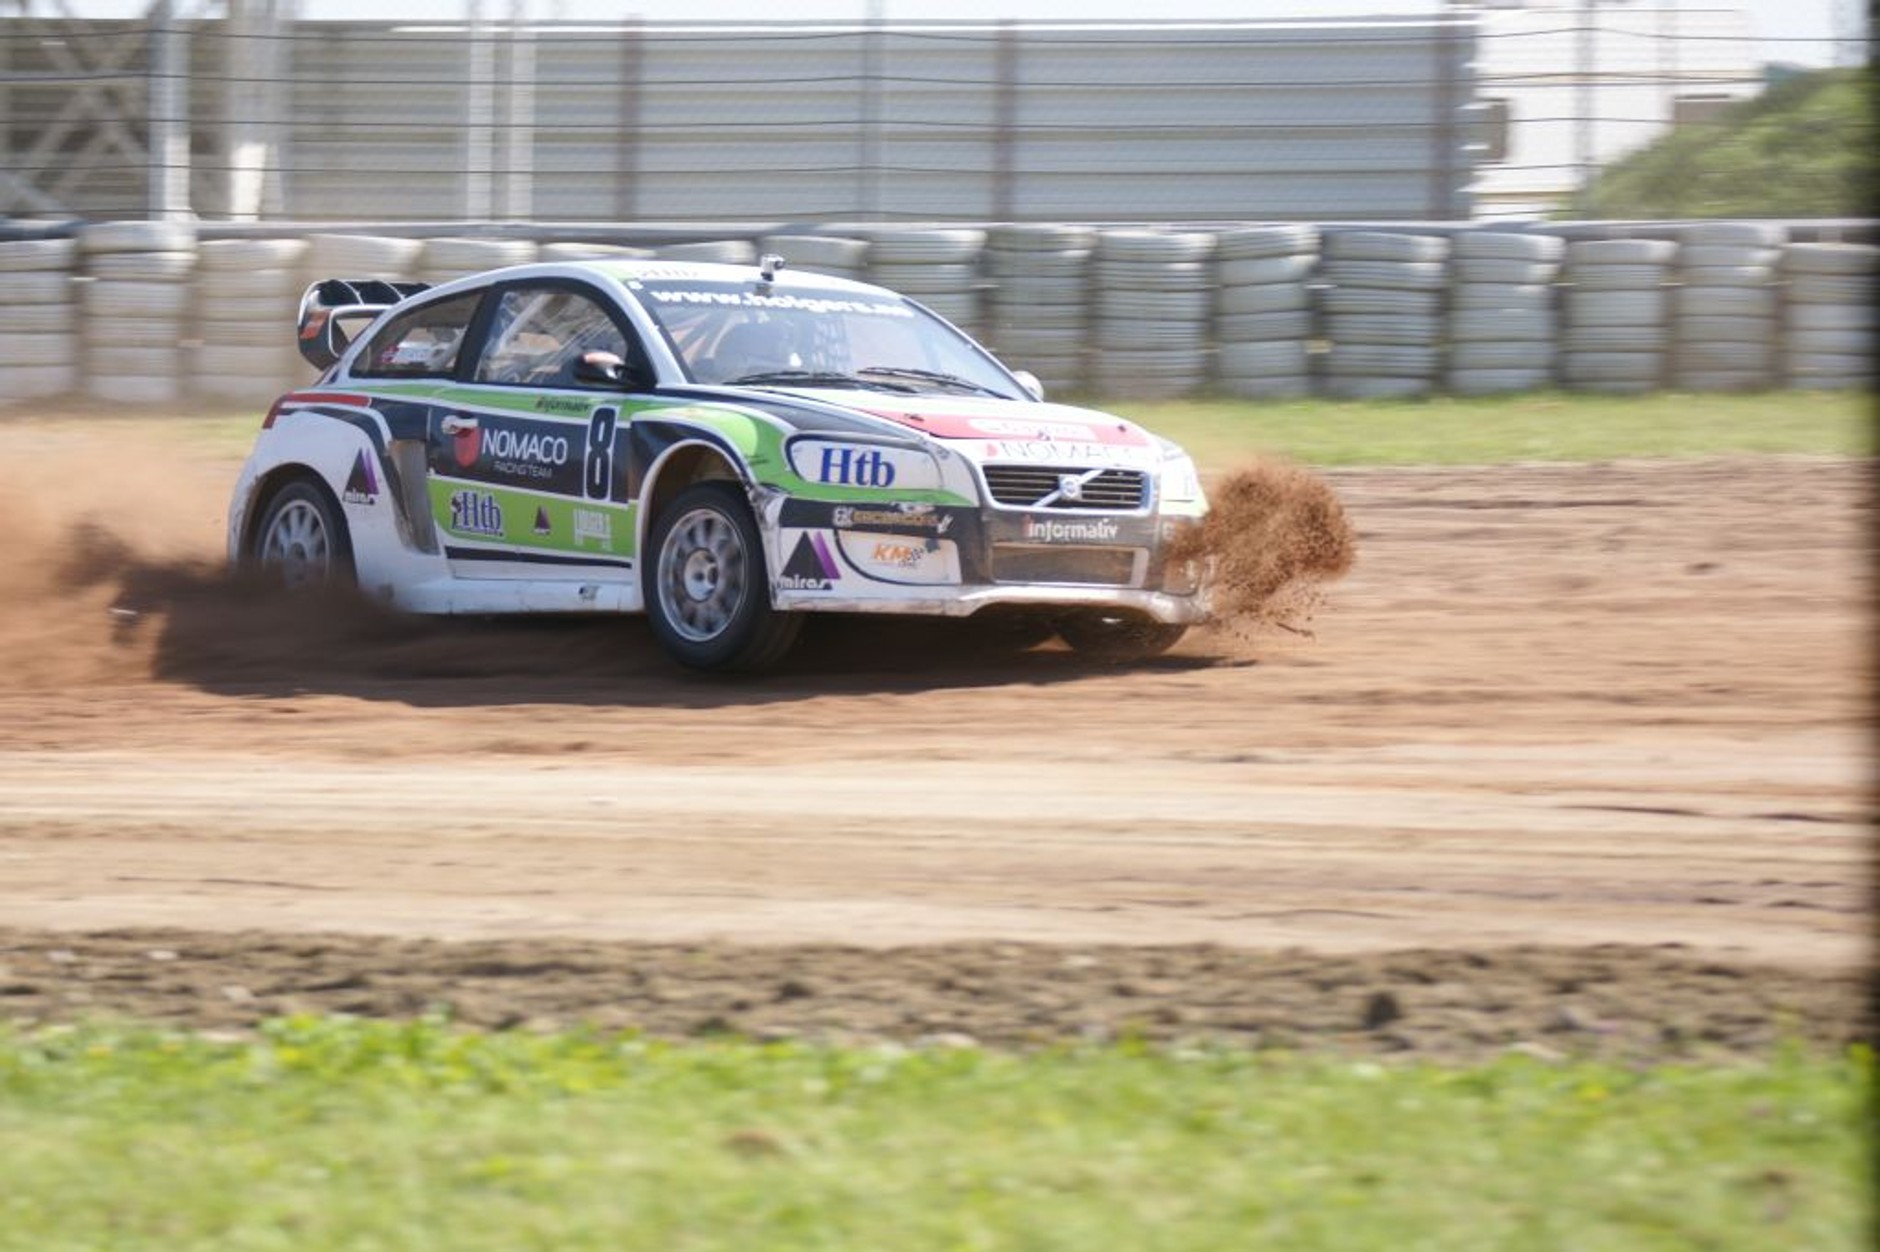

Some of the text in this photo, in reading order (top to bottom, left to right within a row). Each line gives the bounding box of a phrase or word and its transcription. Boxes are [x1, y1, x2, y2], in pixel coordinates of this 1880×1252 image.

[482, 427, 568, 466] NOMACO
[586, 406, 619, 500] 8
[494, 460, 553, 478] RACING TEAM
[820, 448, 896, 488] Htb
[1025, 516, 1118, 542] informativ
